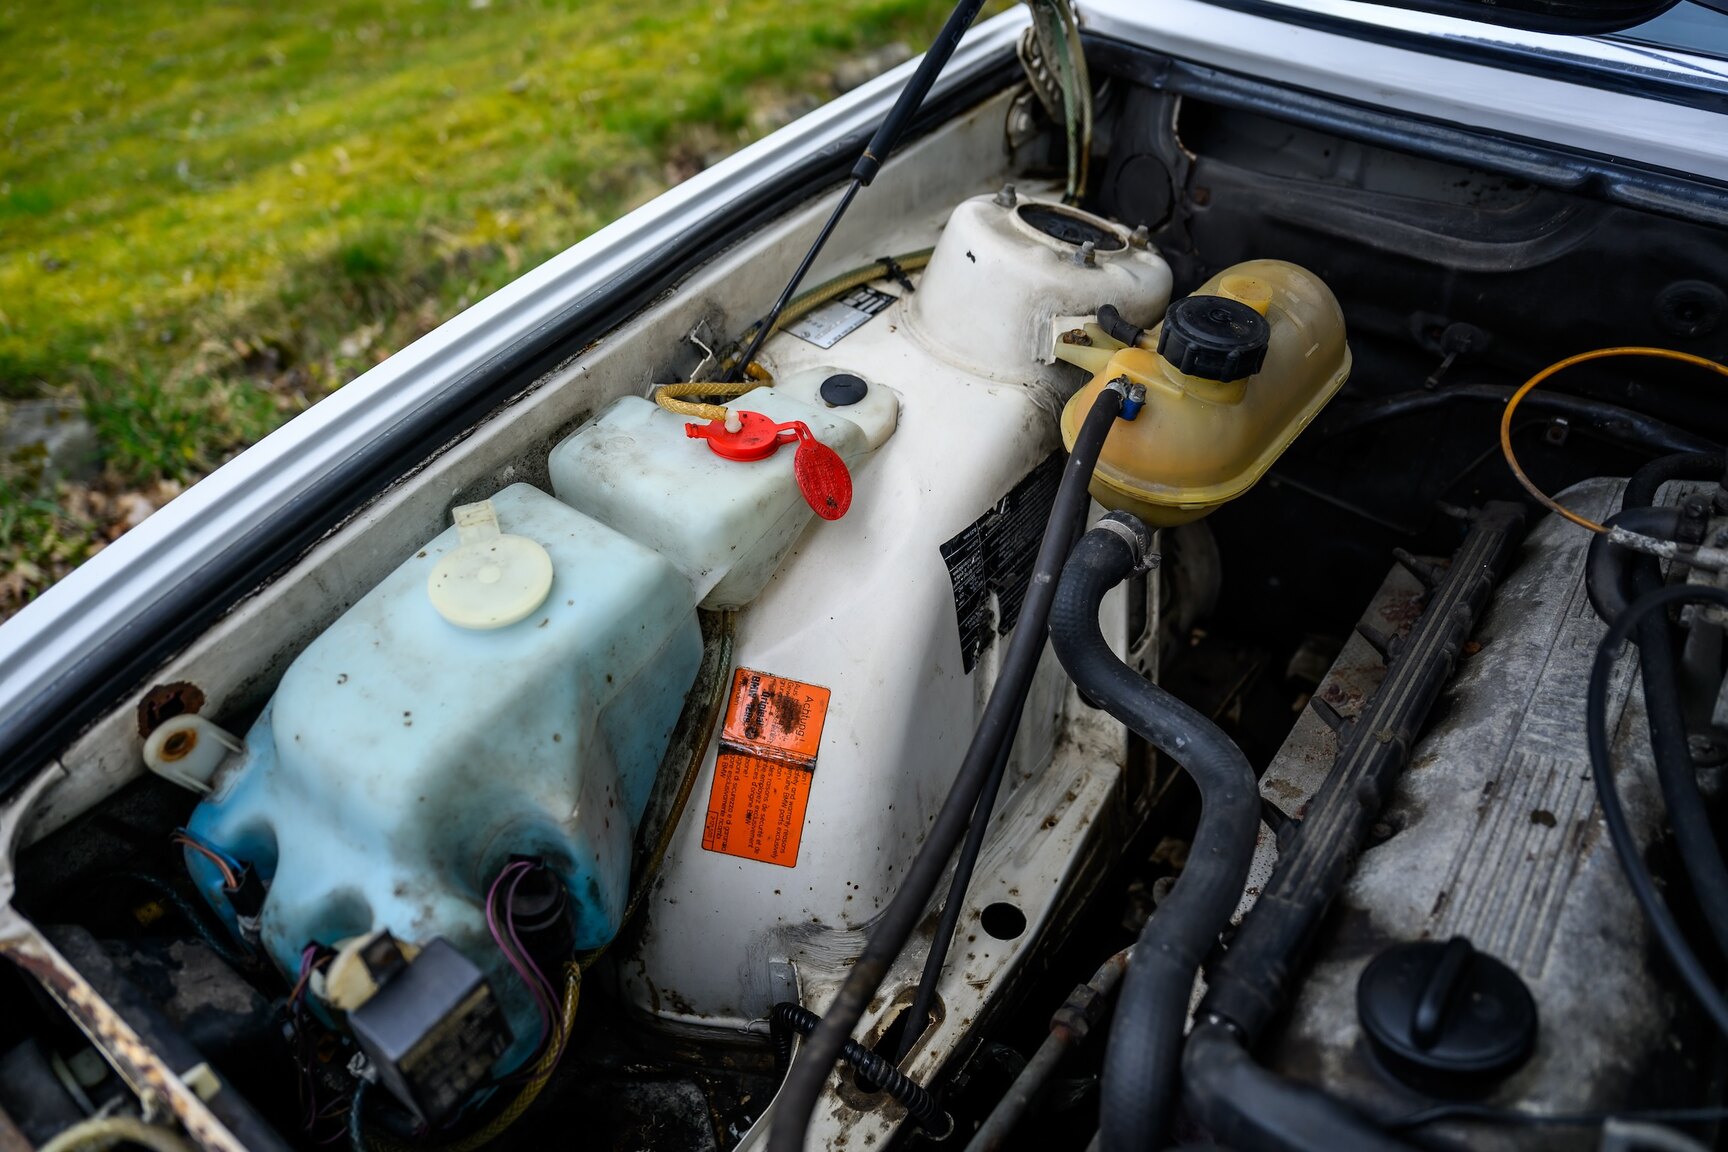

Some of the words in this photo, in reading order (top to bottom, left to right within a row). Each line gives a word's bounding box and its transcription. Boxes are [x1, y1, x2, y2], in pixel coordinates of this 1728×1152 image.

[747, 675, 760, 698] BMW
[795, 694, 814, 737] Achtung
[719, 761, 728, 779] BMW
[767, 764, 776, 777] des
[753, 773, 766, 803] employez
[762, 778, 773, 802] raisons
[780, 791, 789, 808] BMW
[789, 787, 797, 800] and
[743, 808, 753, 825] BW
[760, 803, 769, 812] de
[775, 808, 786, 826] parts
[782, 800, 795, 828] warranty
[746, 804, 761, 848] exclusivement
[769, 826, 783, 860] exclusively
[779, 828, 789, 854] reasons
